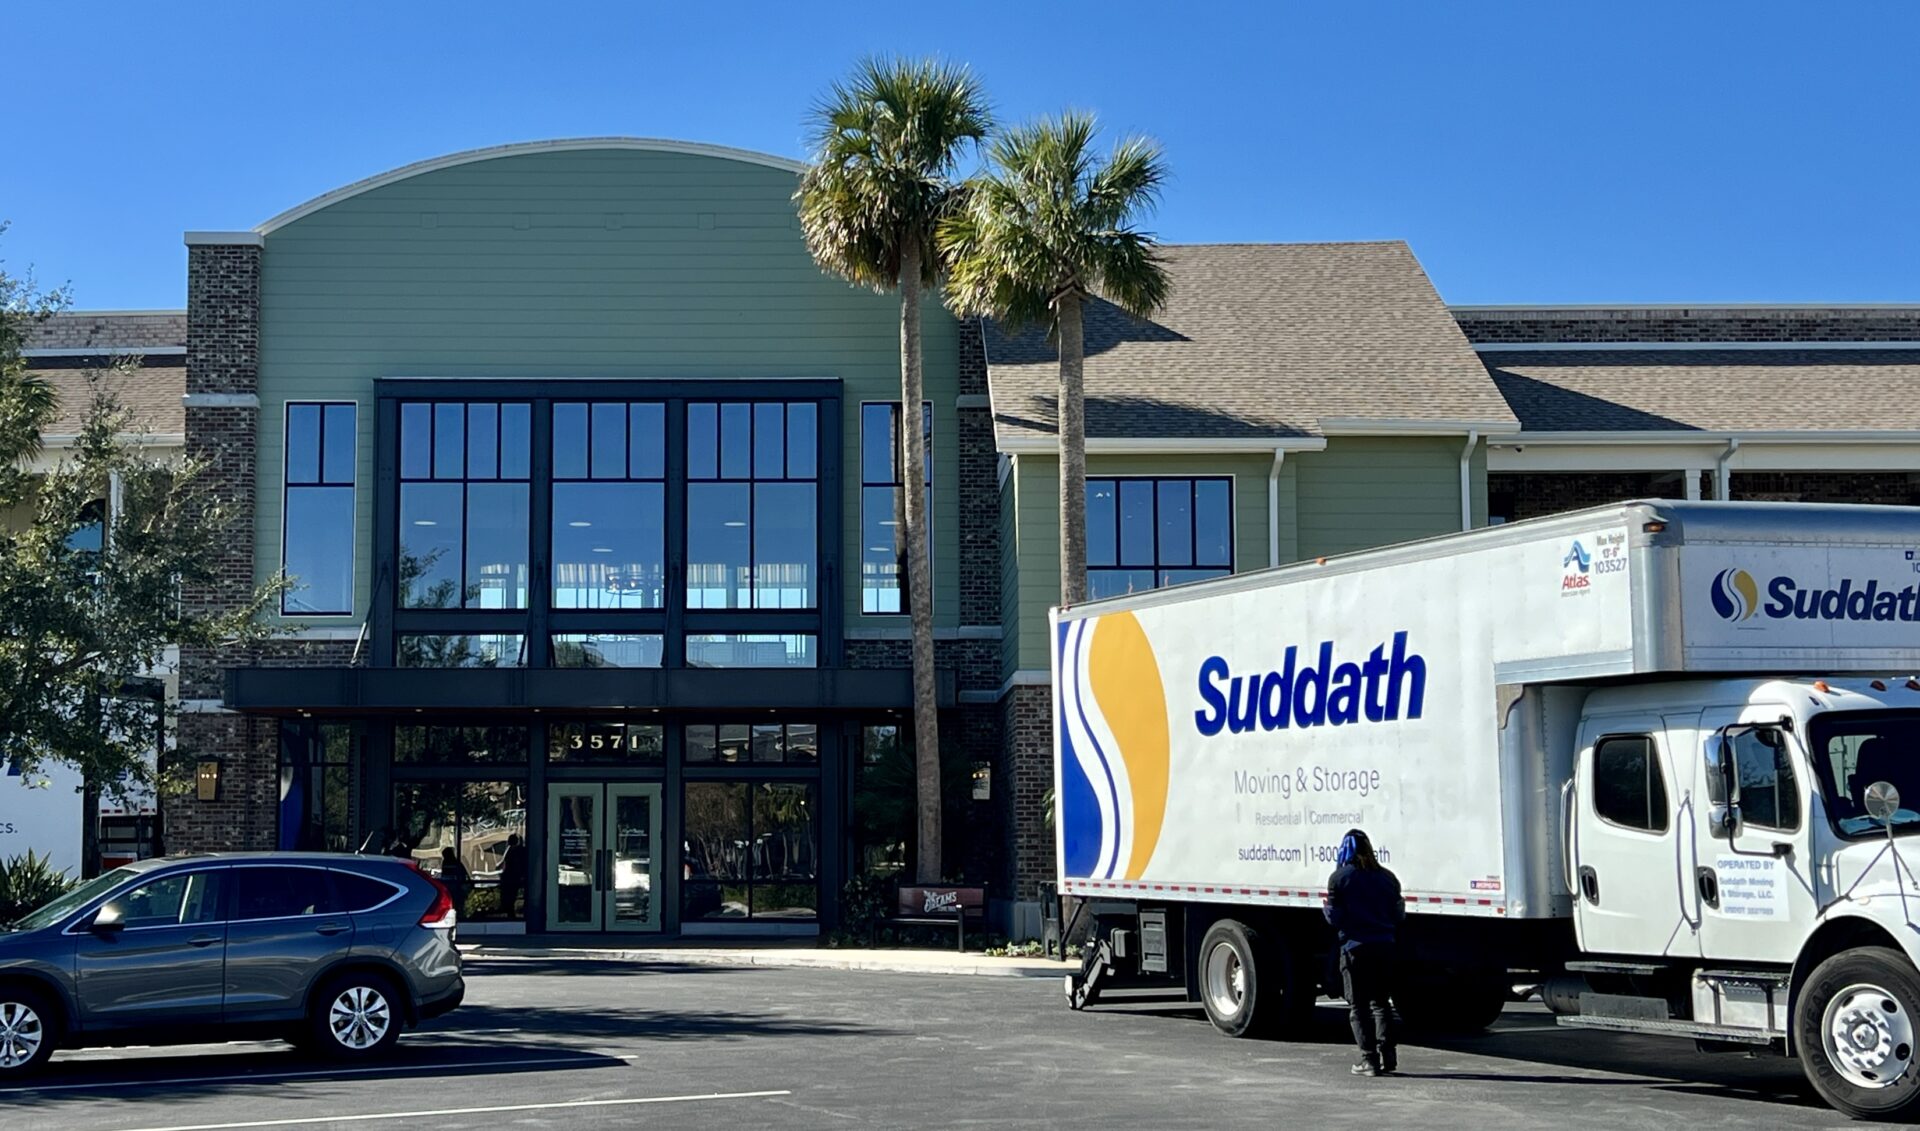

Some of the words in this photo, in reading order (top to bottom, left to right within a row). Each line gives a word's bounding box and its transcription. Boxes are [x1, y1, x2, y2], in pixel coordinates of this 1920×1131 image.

[1594, 557, 1627, 574] 103527
[1195, 630, 1426, 736] Suddath
[570, 734, 638, 749] 3571
[1234, 768, 1291, 799] Moving
[1296, 766, 1308, 793] &
[1313, 766, 1380, 797] Storage
[1255, 809, 1302, 826] Residential
[1309, 809, 1364, 825] Commercial
[1238, 844, 1301, 862] suddath.com
[1717, 860, 1761, 870] OPERATED
[1763, 861, 1774, 870] BY
